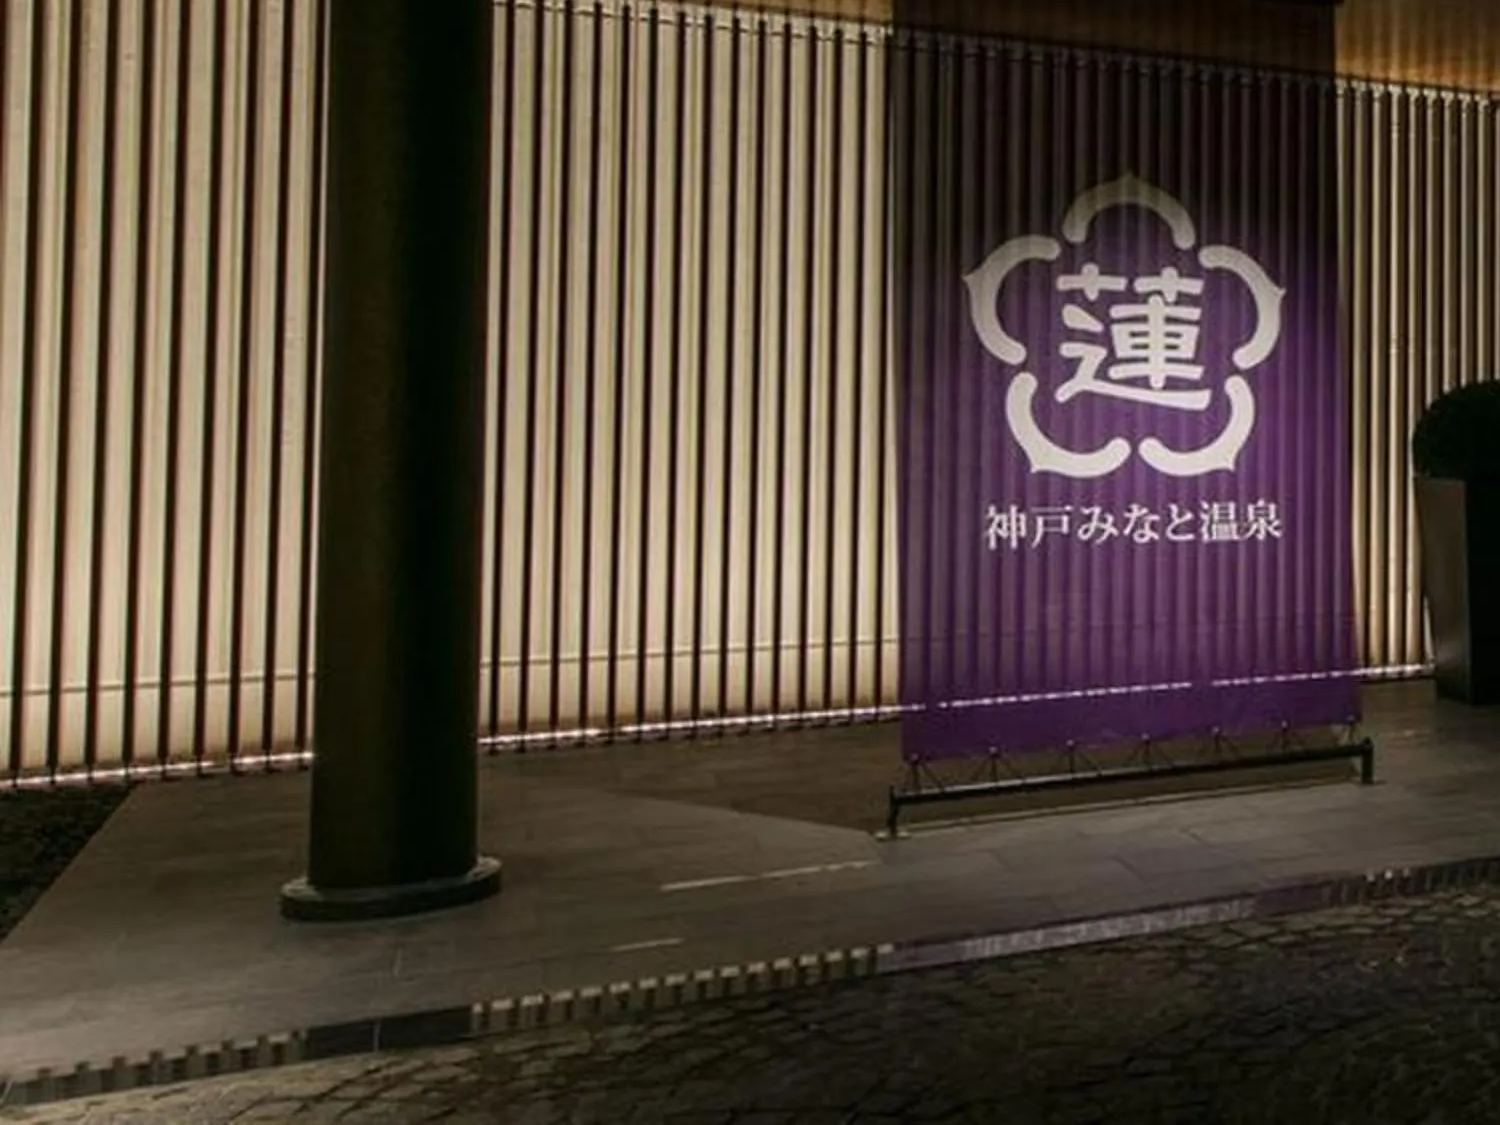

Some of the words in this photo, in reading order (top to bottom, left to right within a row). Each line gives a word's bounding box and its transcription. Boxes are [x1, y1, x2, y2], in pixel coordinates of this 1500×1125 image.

[1055, 262, 1213, 411] 蓮
[984, 499, 1284, 551] 神戸みなと温泉
